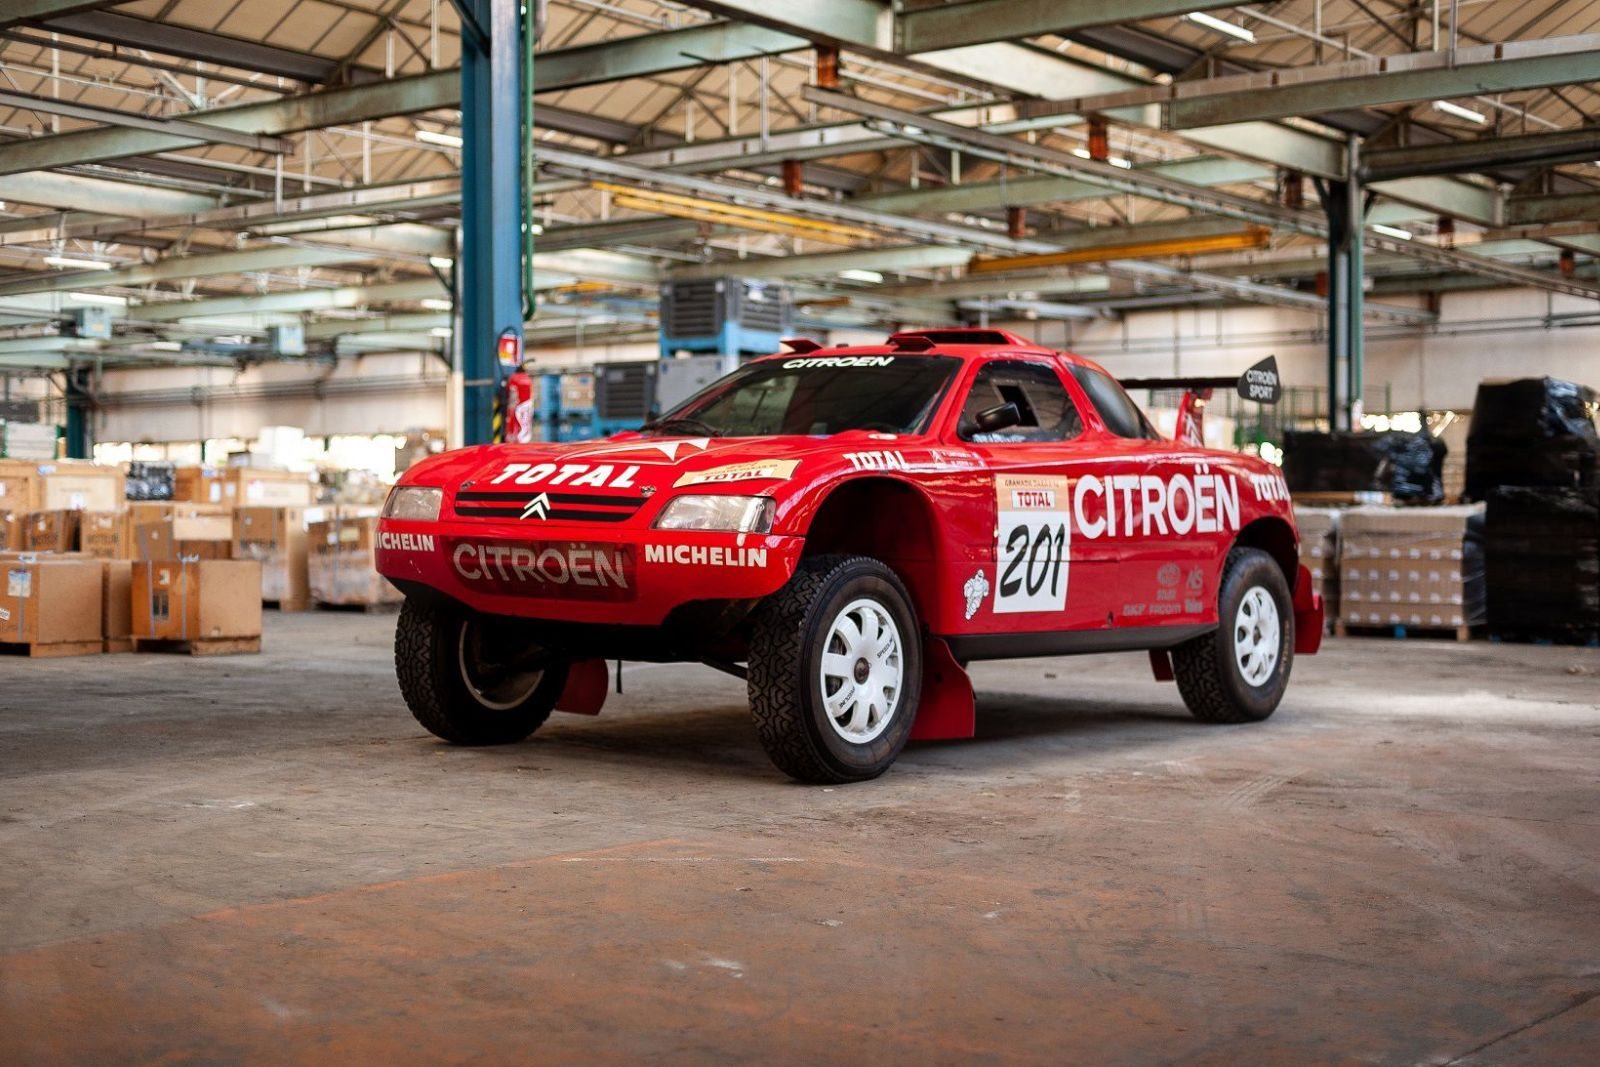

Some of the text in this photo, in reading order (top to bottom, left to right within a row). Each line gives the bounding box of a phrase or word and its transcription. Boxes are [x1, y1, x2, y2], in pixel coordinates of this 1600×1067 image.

[1249, 384, 1273, 399] SPORT
[842, 450, 910, 471] TOTAL
[490, 463, 641, 488] TOTAL
[704, 470, 763, 481] TOTAL
[1017, 491, 1051, 507] TOTAL
[1074, 463, 1240, 540] CITROËN
[453, 542, 628, 589] CITROËN
[644, 544, 768, 568] MICHELIN
[999, 522, 1066, 598] 201
